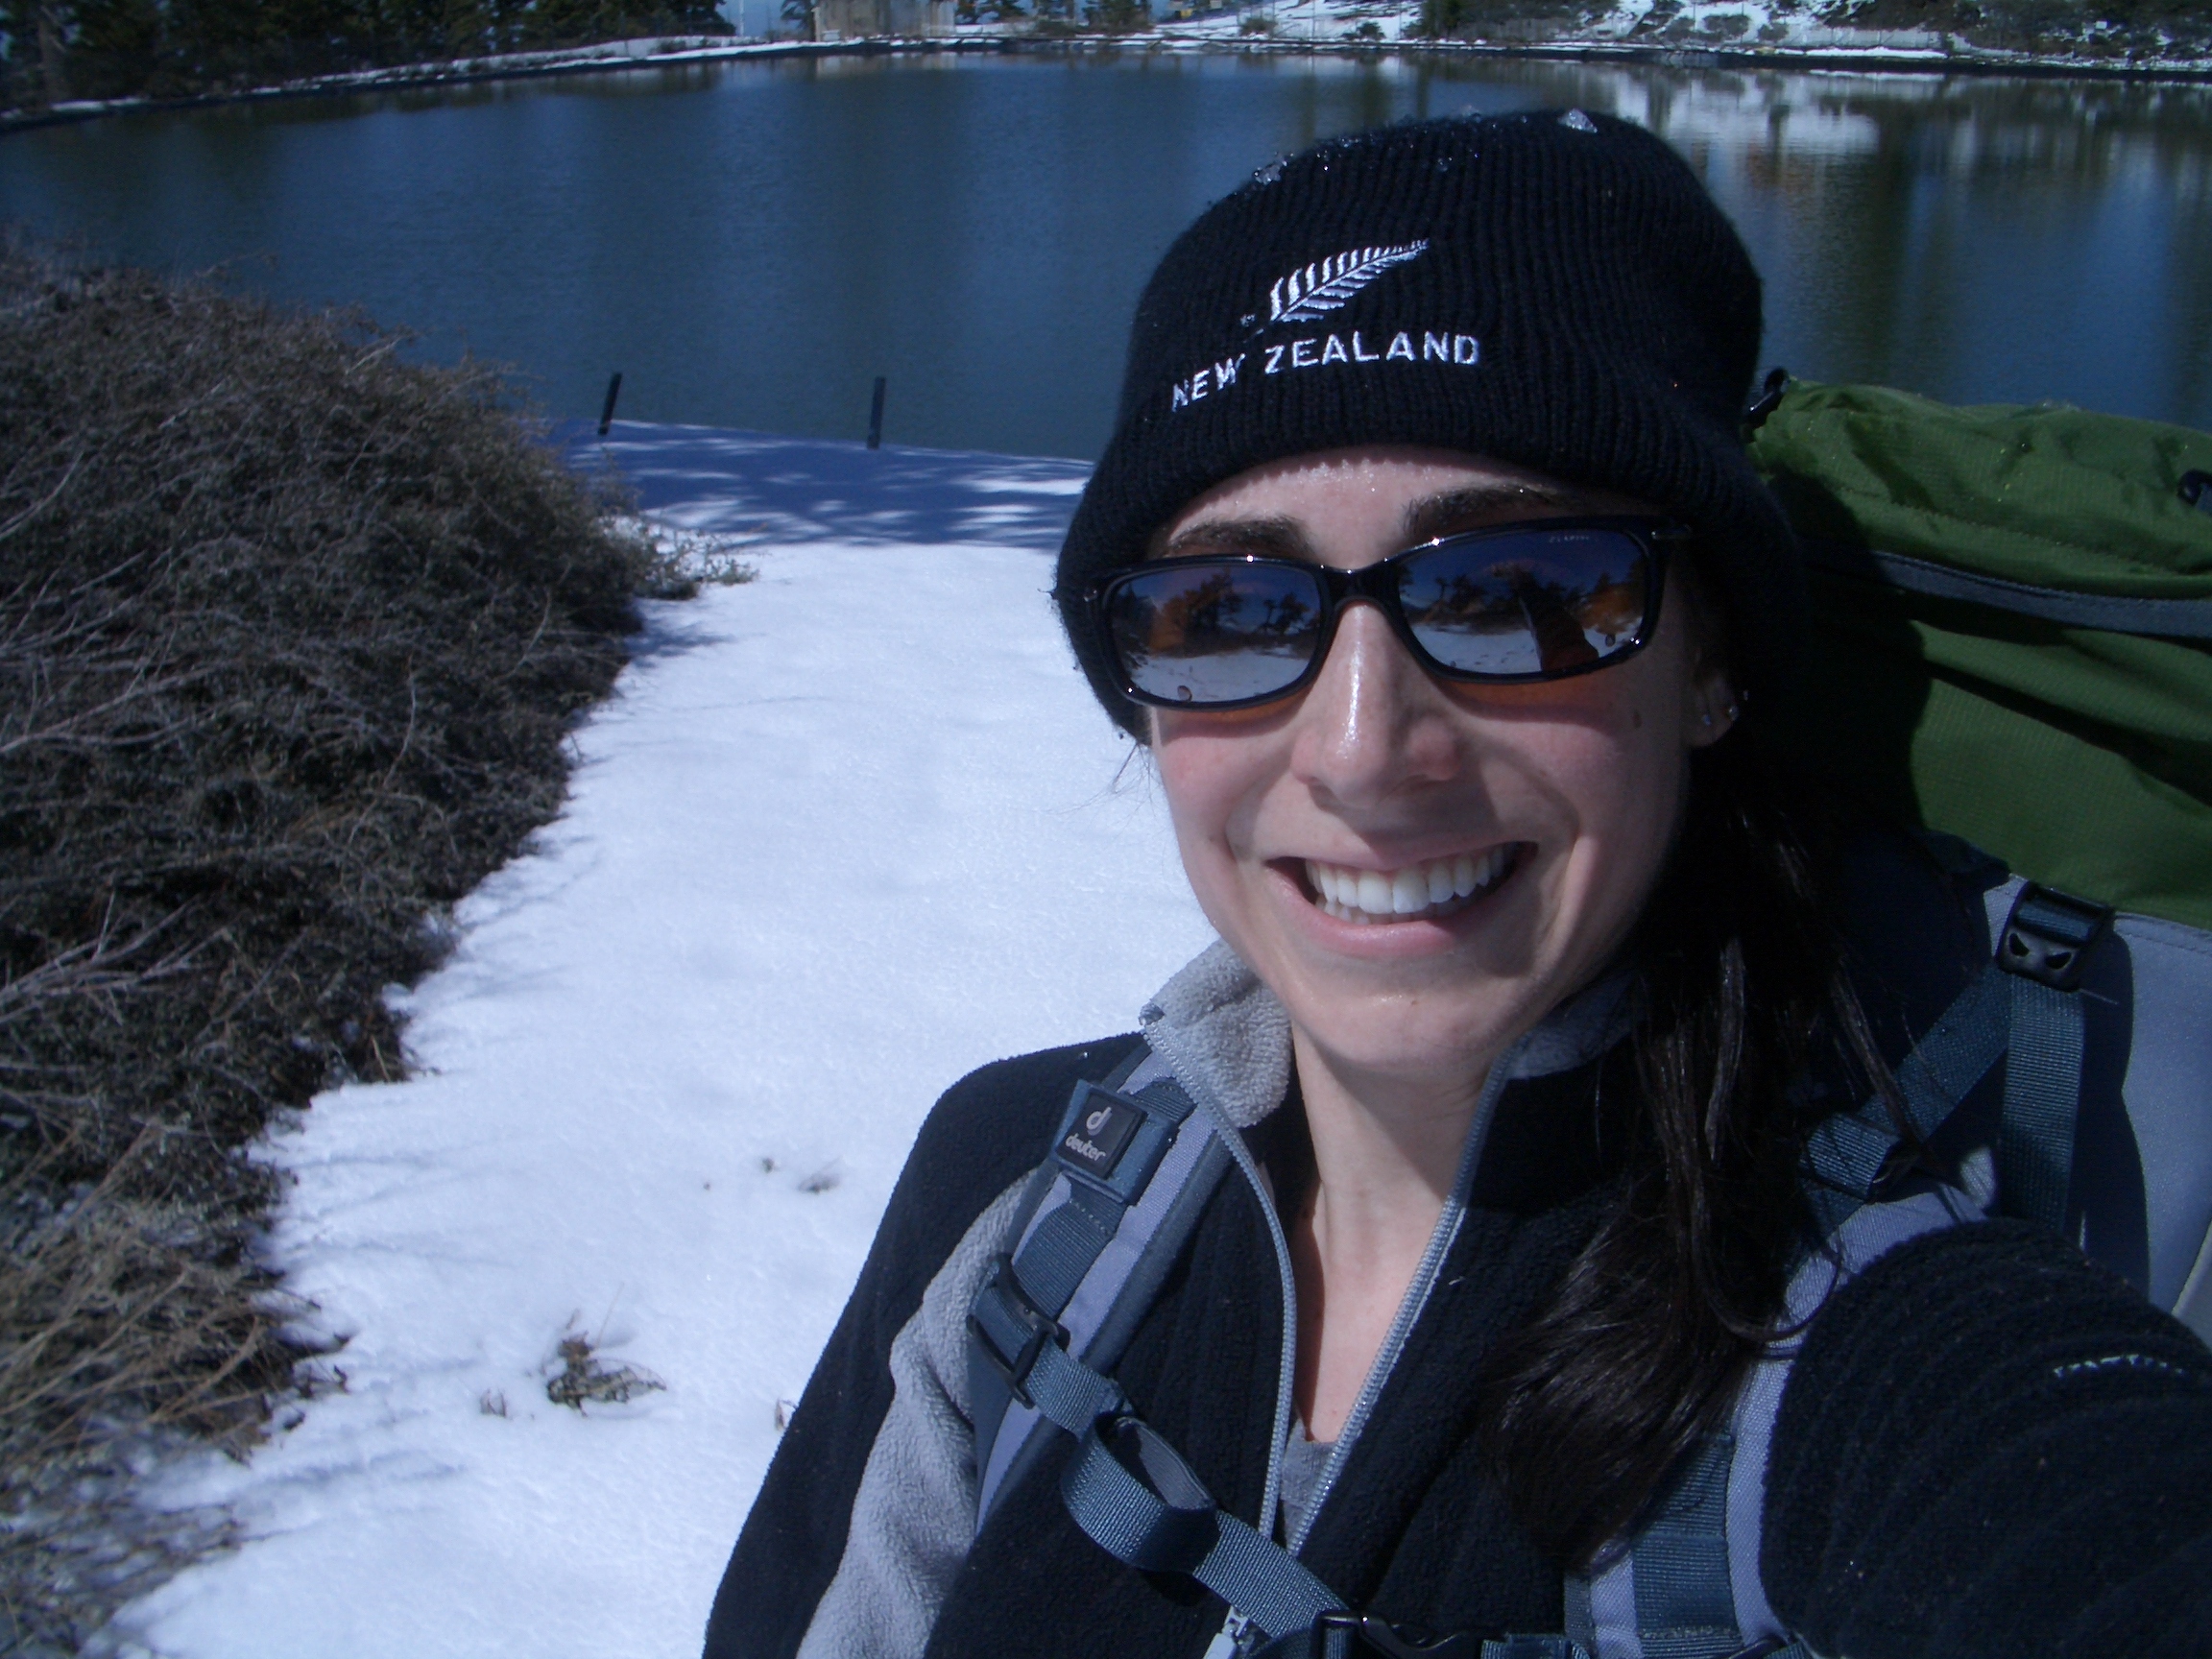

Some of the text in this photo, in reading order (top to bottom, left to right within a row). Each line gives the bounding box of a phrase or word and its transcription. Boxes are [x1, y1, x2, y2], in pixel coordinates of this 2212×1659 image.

[1171, 330, 1479, 412] NEW ZEALAND
[1065, 1133, 1107, 1162] deuter
